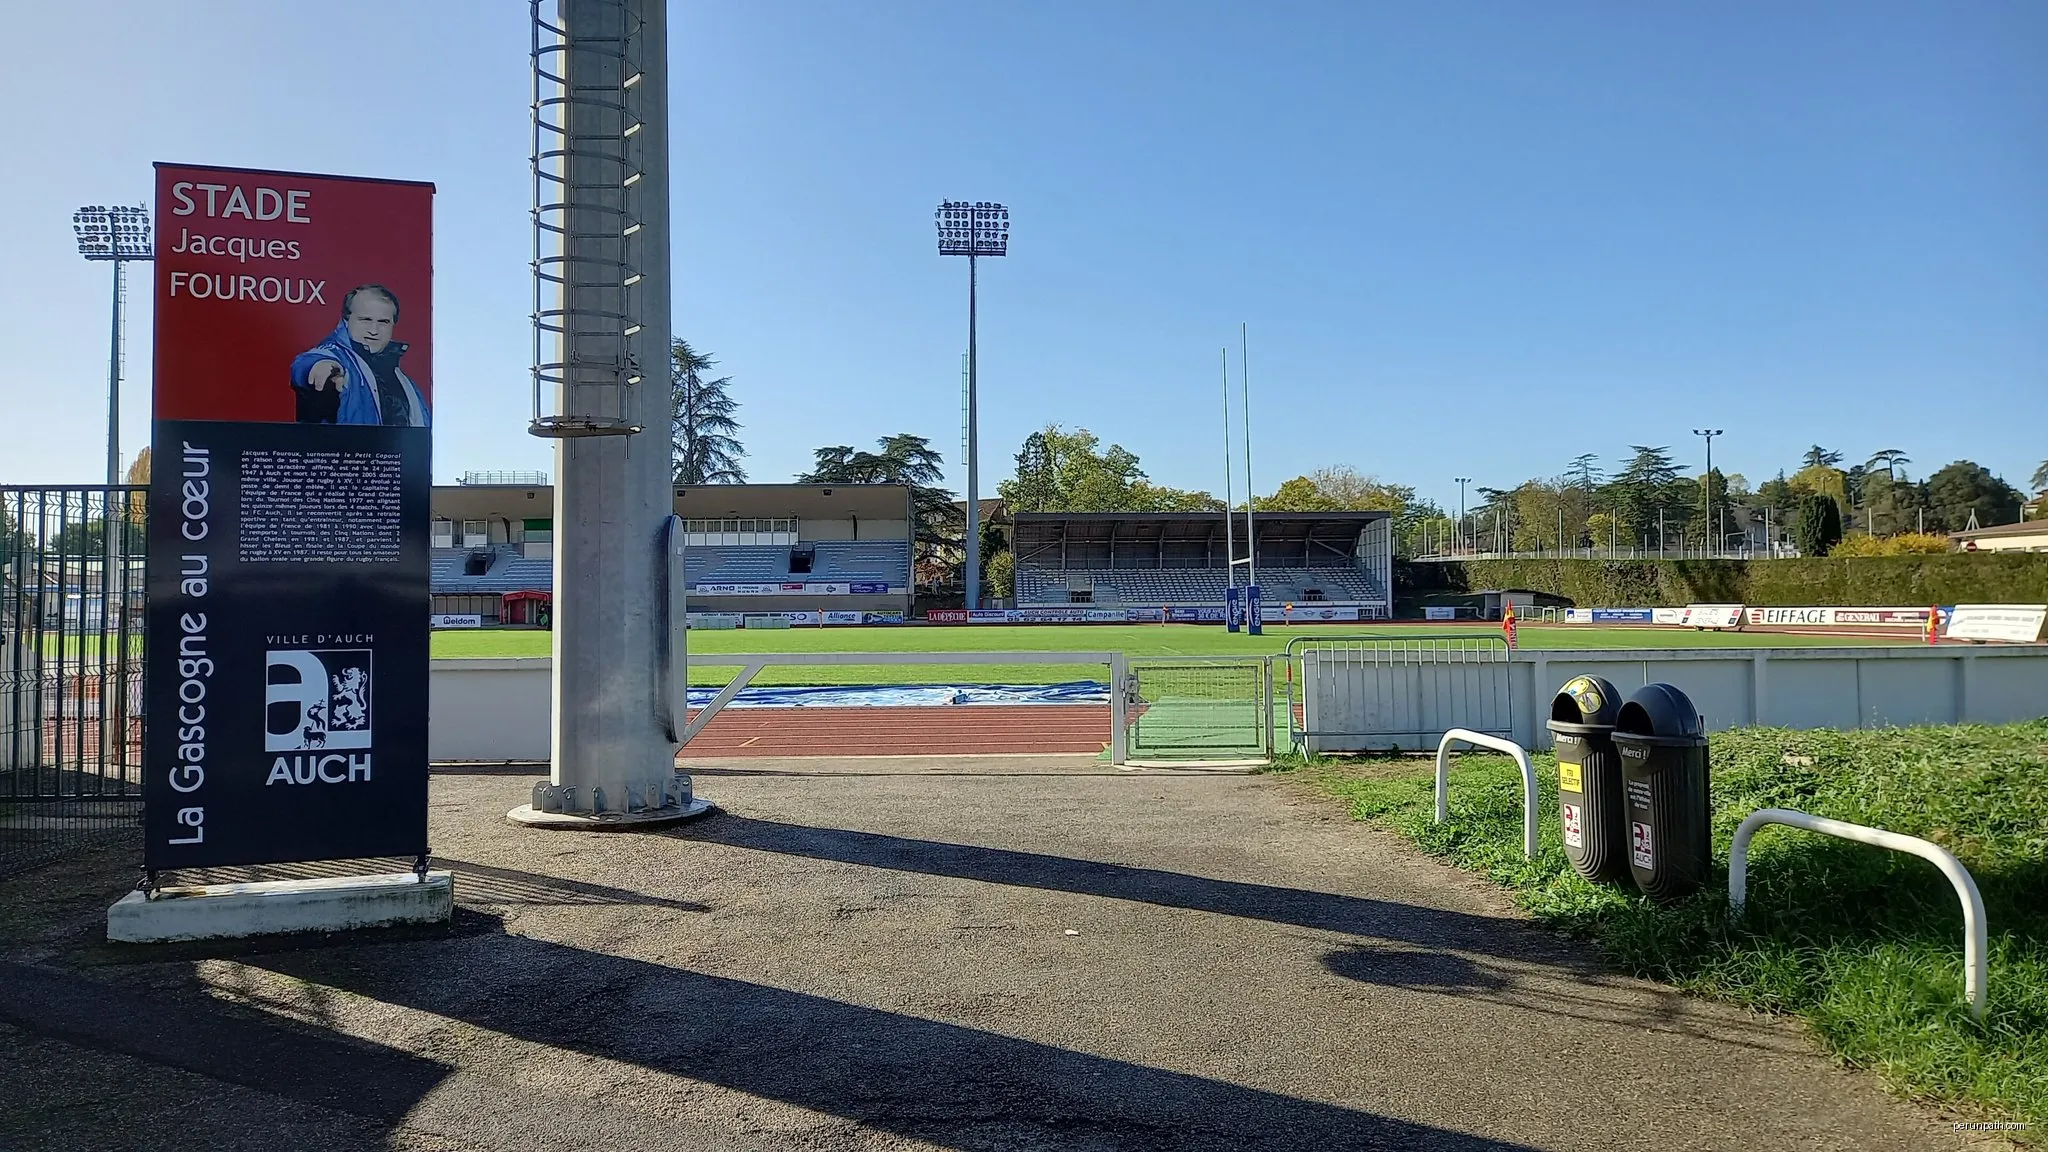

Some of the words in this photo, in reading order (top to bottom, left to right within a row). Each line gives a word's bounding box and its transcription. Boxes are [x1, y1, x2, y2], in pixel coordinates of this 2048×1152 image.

[172, 182, 312, 224] STADE
[172, 228, 302, 264] Jacques
[169, 272, 326, 305] FOUROUX
[182, 441, 210, 542] cœur
[182, 554, 208, 598] au
[1768, 610, 1826, 623] EIFFAGE
[1845, 613, 1879, 622] GENERALI
[266, 635, 309, 644] VILLE
[318, 634, 374, 643] D'AUCH
[169, 612, 214, 793] Gascogne
[1556, 733, 1573, 744] Merci
[1622, 747, 1641, 758] Merci
[265, 754, 371, 786] AUCH
[169, 807, 204, 845] La
